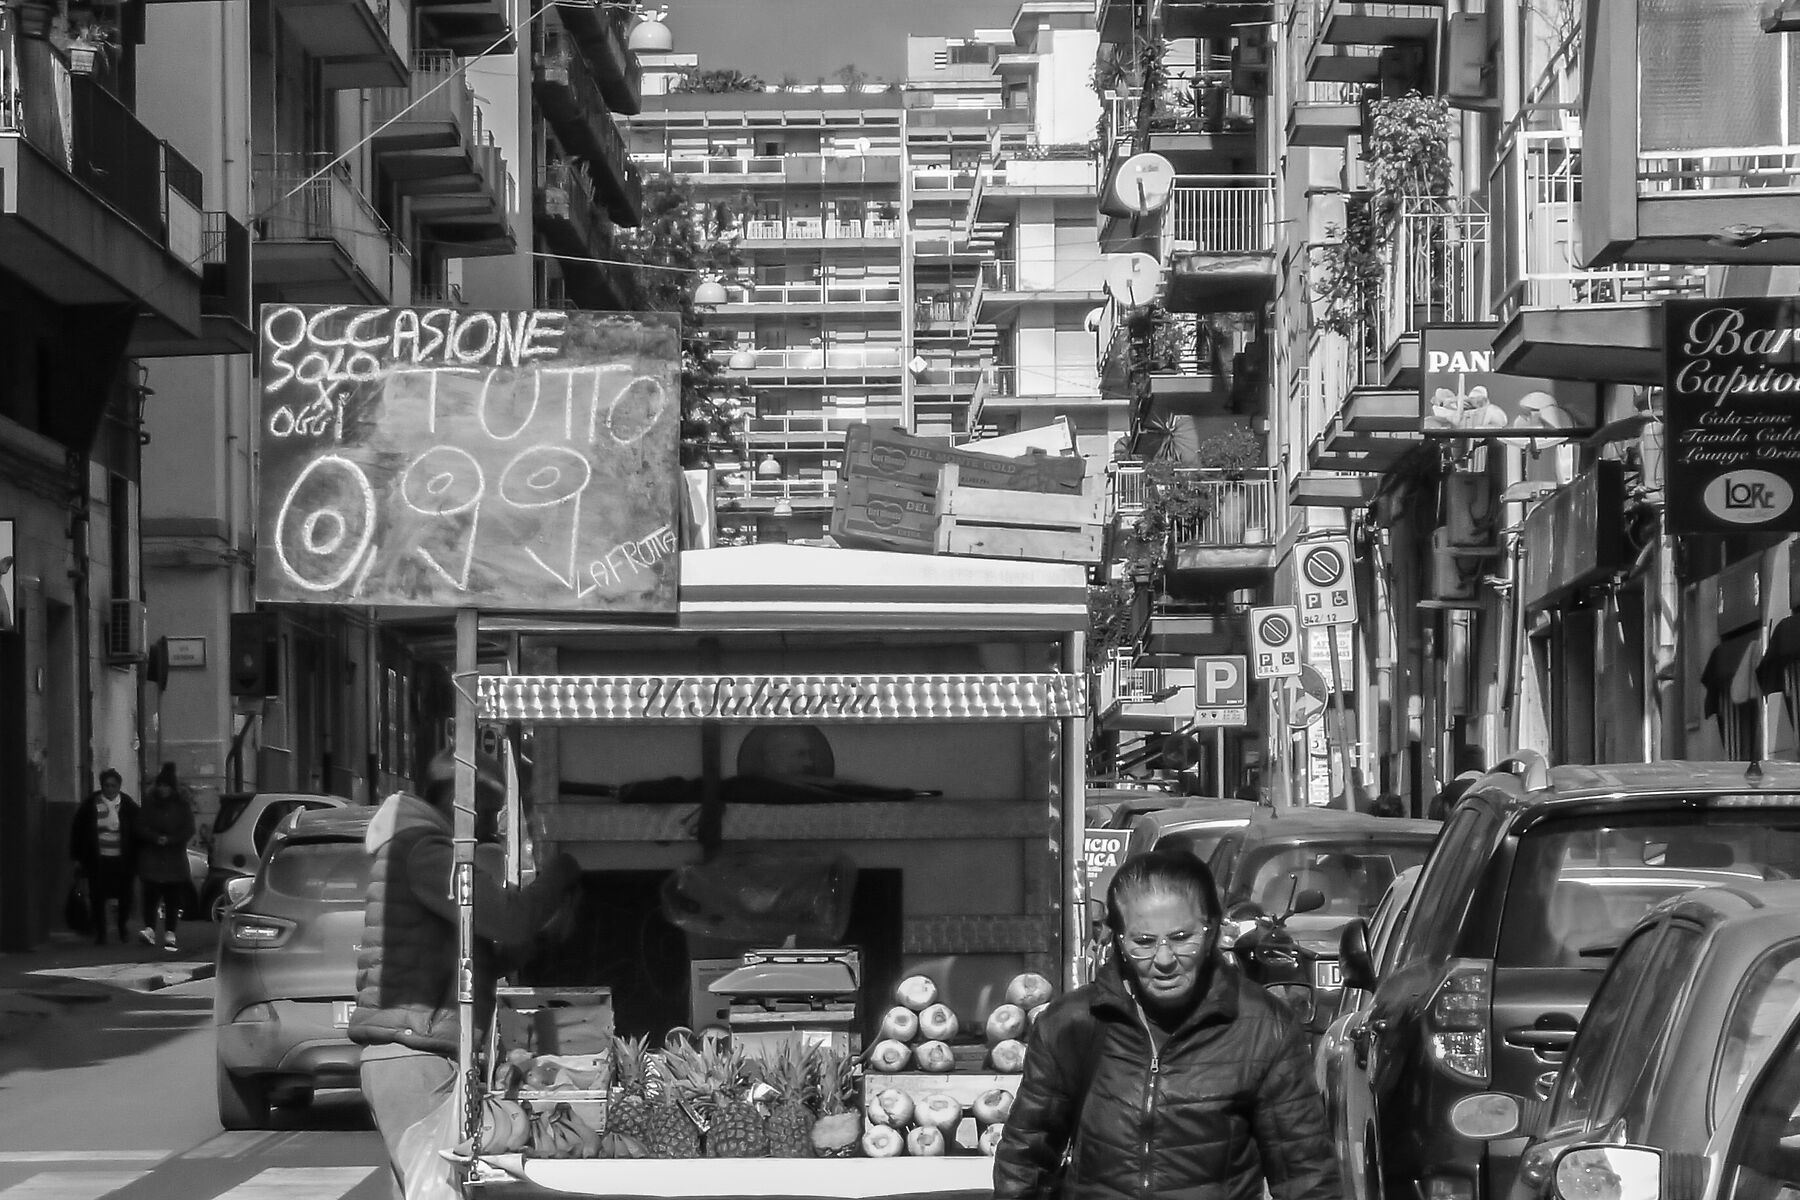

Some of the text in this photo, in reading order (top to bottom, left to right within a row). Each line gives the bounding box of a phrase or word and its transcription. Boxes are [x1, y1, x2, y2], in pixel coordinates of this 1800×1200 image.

[265, 307, 568, 367] OCCASIONE
[1684, 307, 1800, 356] Bar
[265, 348, 382, 392] SOLO
[1428, 350, 1495, 373] PAN
[1676, 359, 1800, 407] Capito
[270, 392, 352, 441] OGGI
[396, 363, 666, 444] TUTTO
[1699, 410, 1792, 425] Colazione
[1679, 427, 1748, 442] Tavola
[909, 447, 933, 460] DEL
[983, 461, 1017, 474] GOLD
[1679, 446, 1749, 465] Lounge
[905, 501, 929, 513] DEL
[1206, 661, 1237, 704] P
[1084, 853, 1117, 867] ICA
